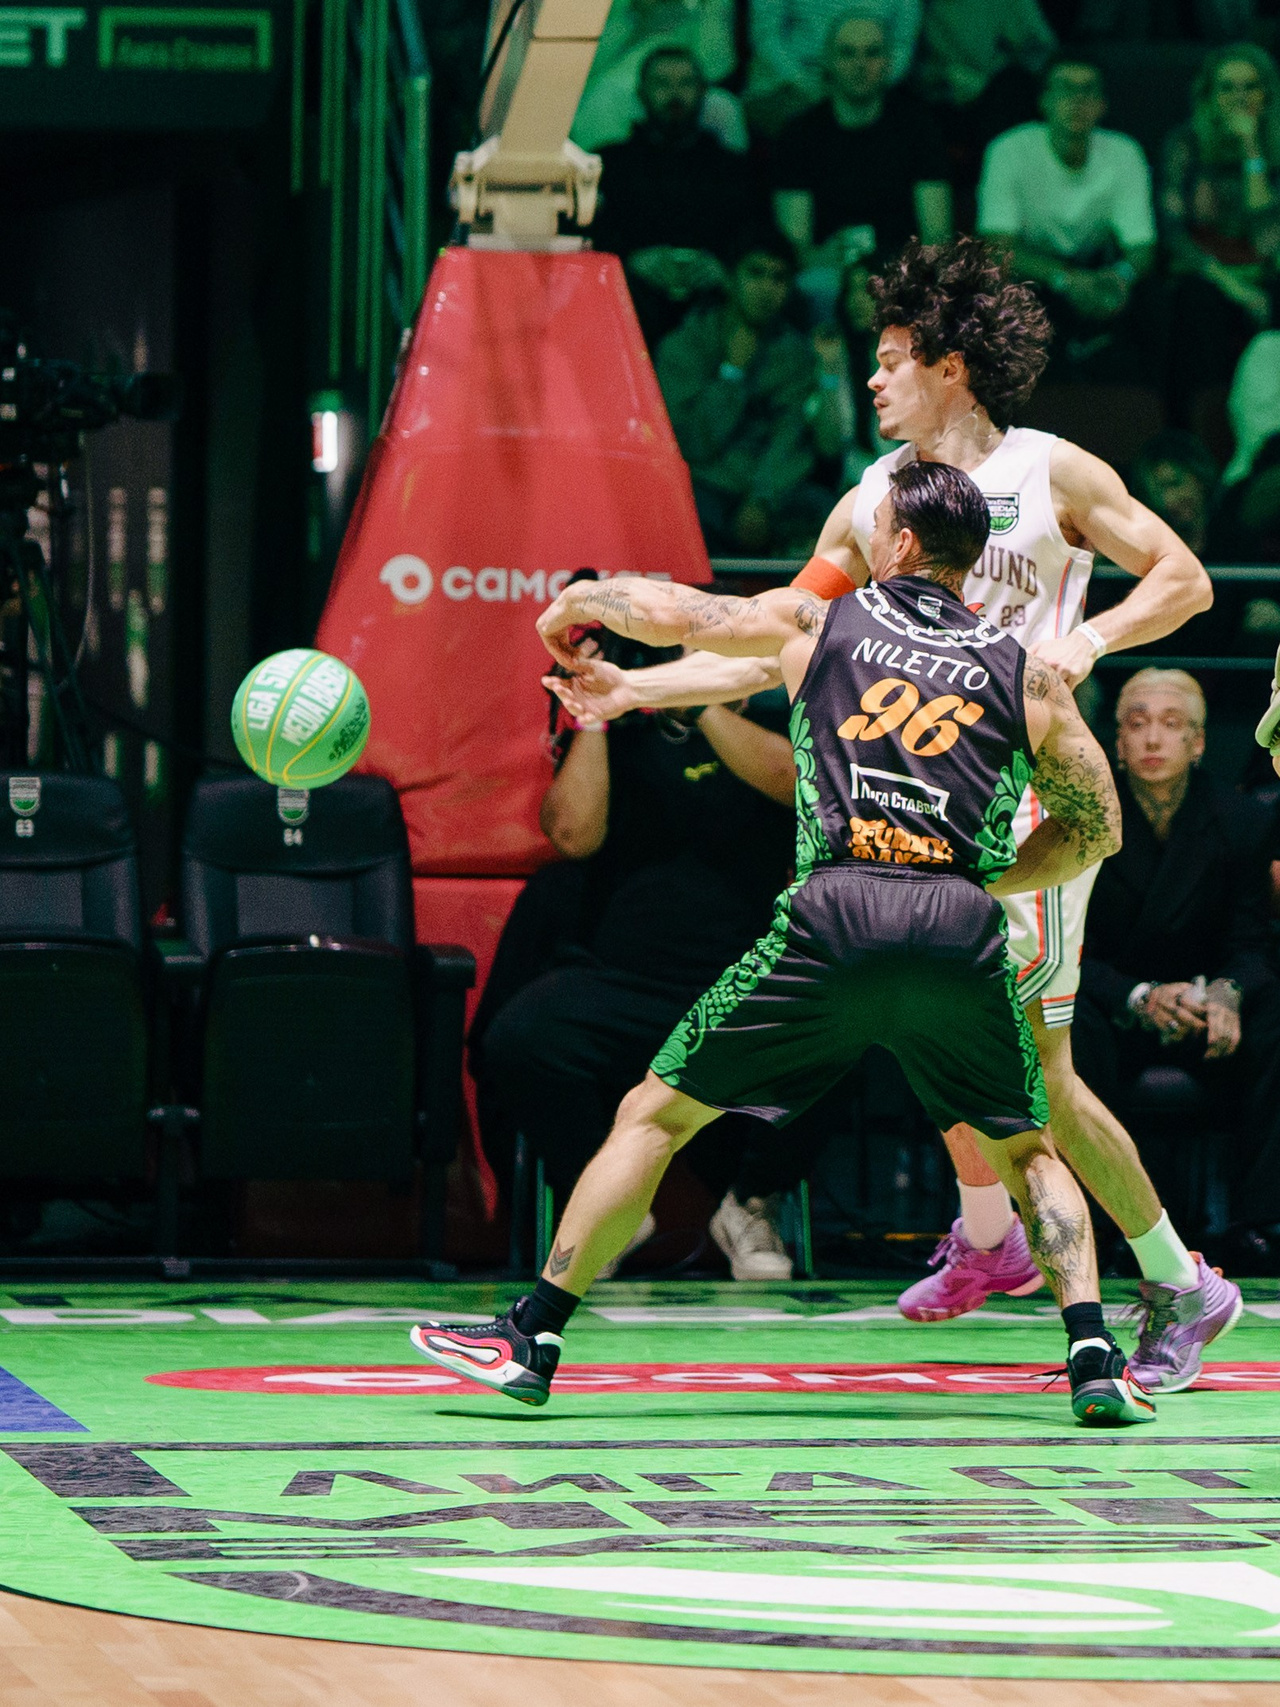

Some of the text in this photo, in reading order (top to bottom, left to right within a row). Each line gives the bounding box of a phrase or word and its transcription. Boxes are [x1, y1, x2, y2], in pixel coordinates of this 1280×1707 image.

[972, 545, 1038, 597] OUND
[1001, 605, 1025, 627] 23
[852, 637, 990, 691] NILETTO
[246, 690, 282, 731] LIGA
[280, 696, 330, 747] MEDIA
[837, 678, 984, 757] 96
[280, 1469, 930, 1497] ЛИГА
